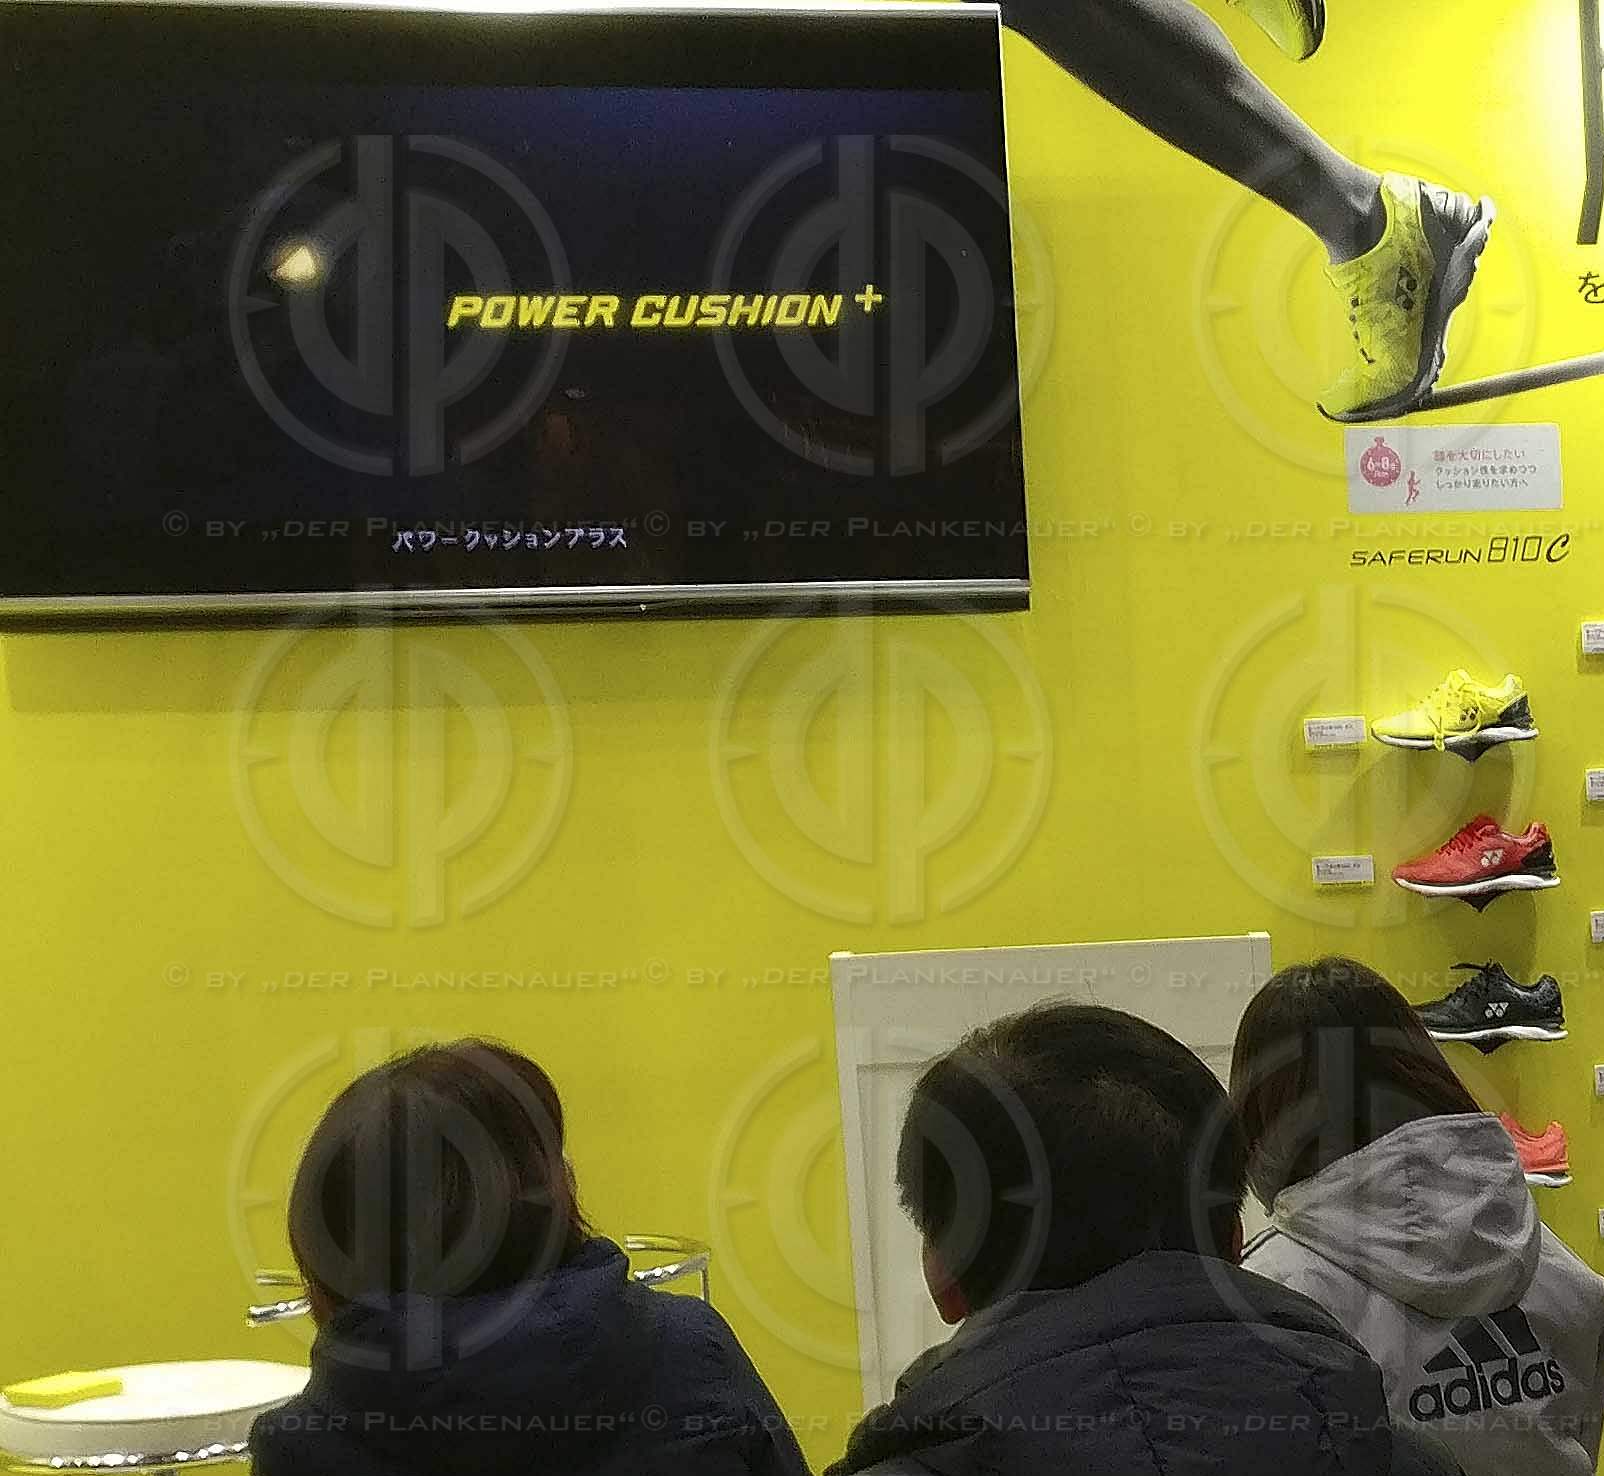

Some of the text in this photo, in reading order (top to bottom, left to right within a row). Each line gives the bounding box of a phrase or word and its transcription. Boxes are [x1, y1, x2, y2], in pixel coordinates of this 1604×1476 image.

[447, 294, 621, 330] POWER
[629, 294, 843, 330] CUSHION
[1349, 547, 1483, 567] SAFERUN
[1408, 1357, 1566, 1423] adidas
